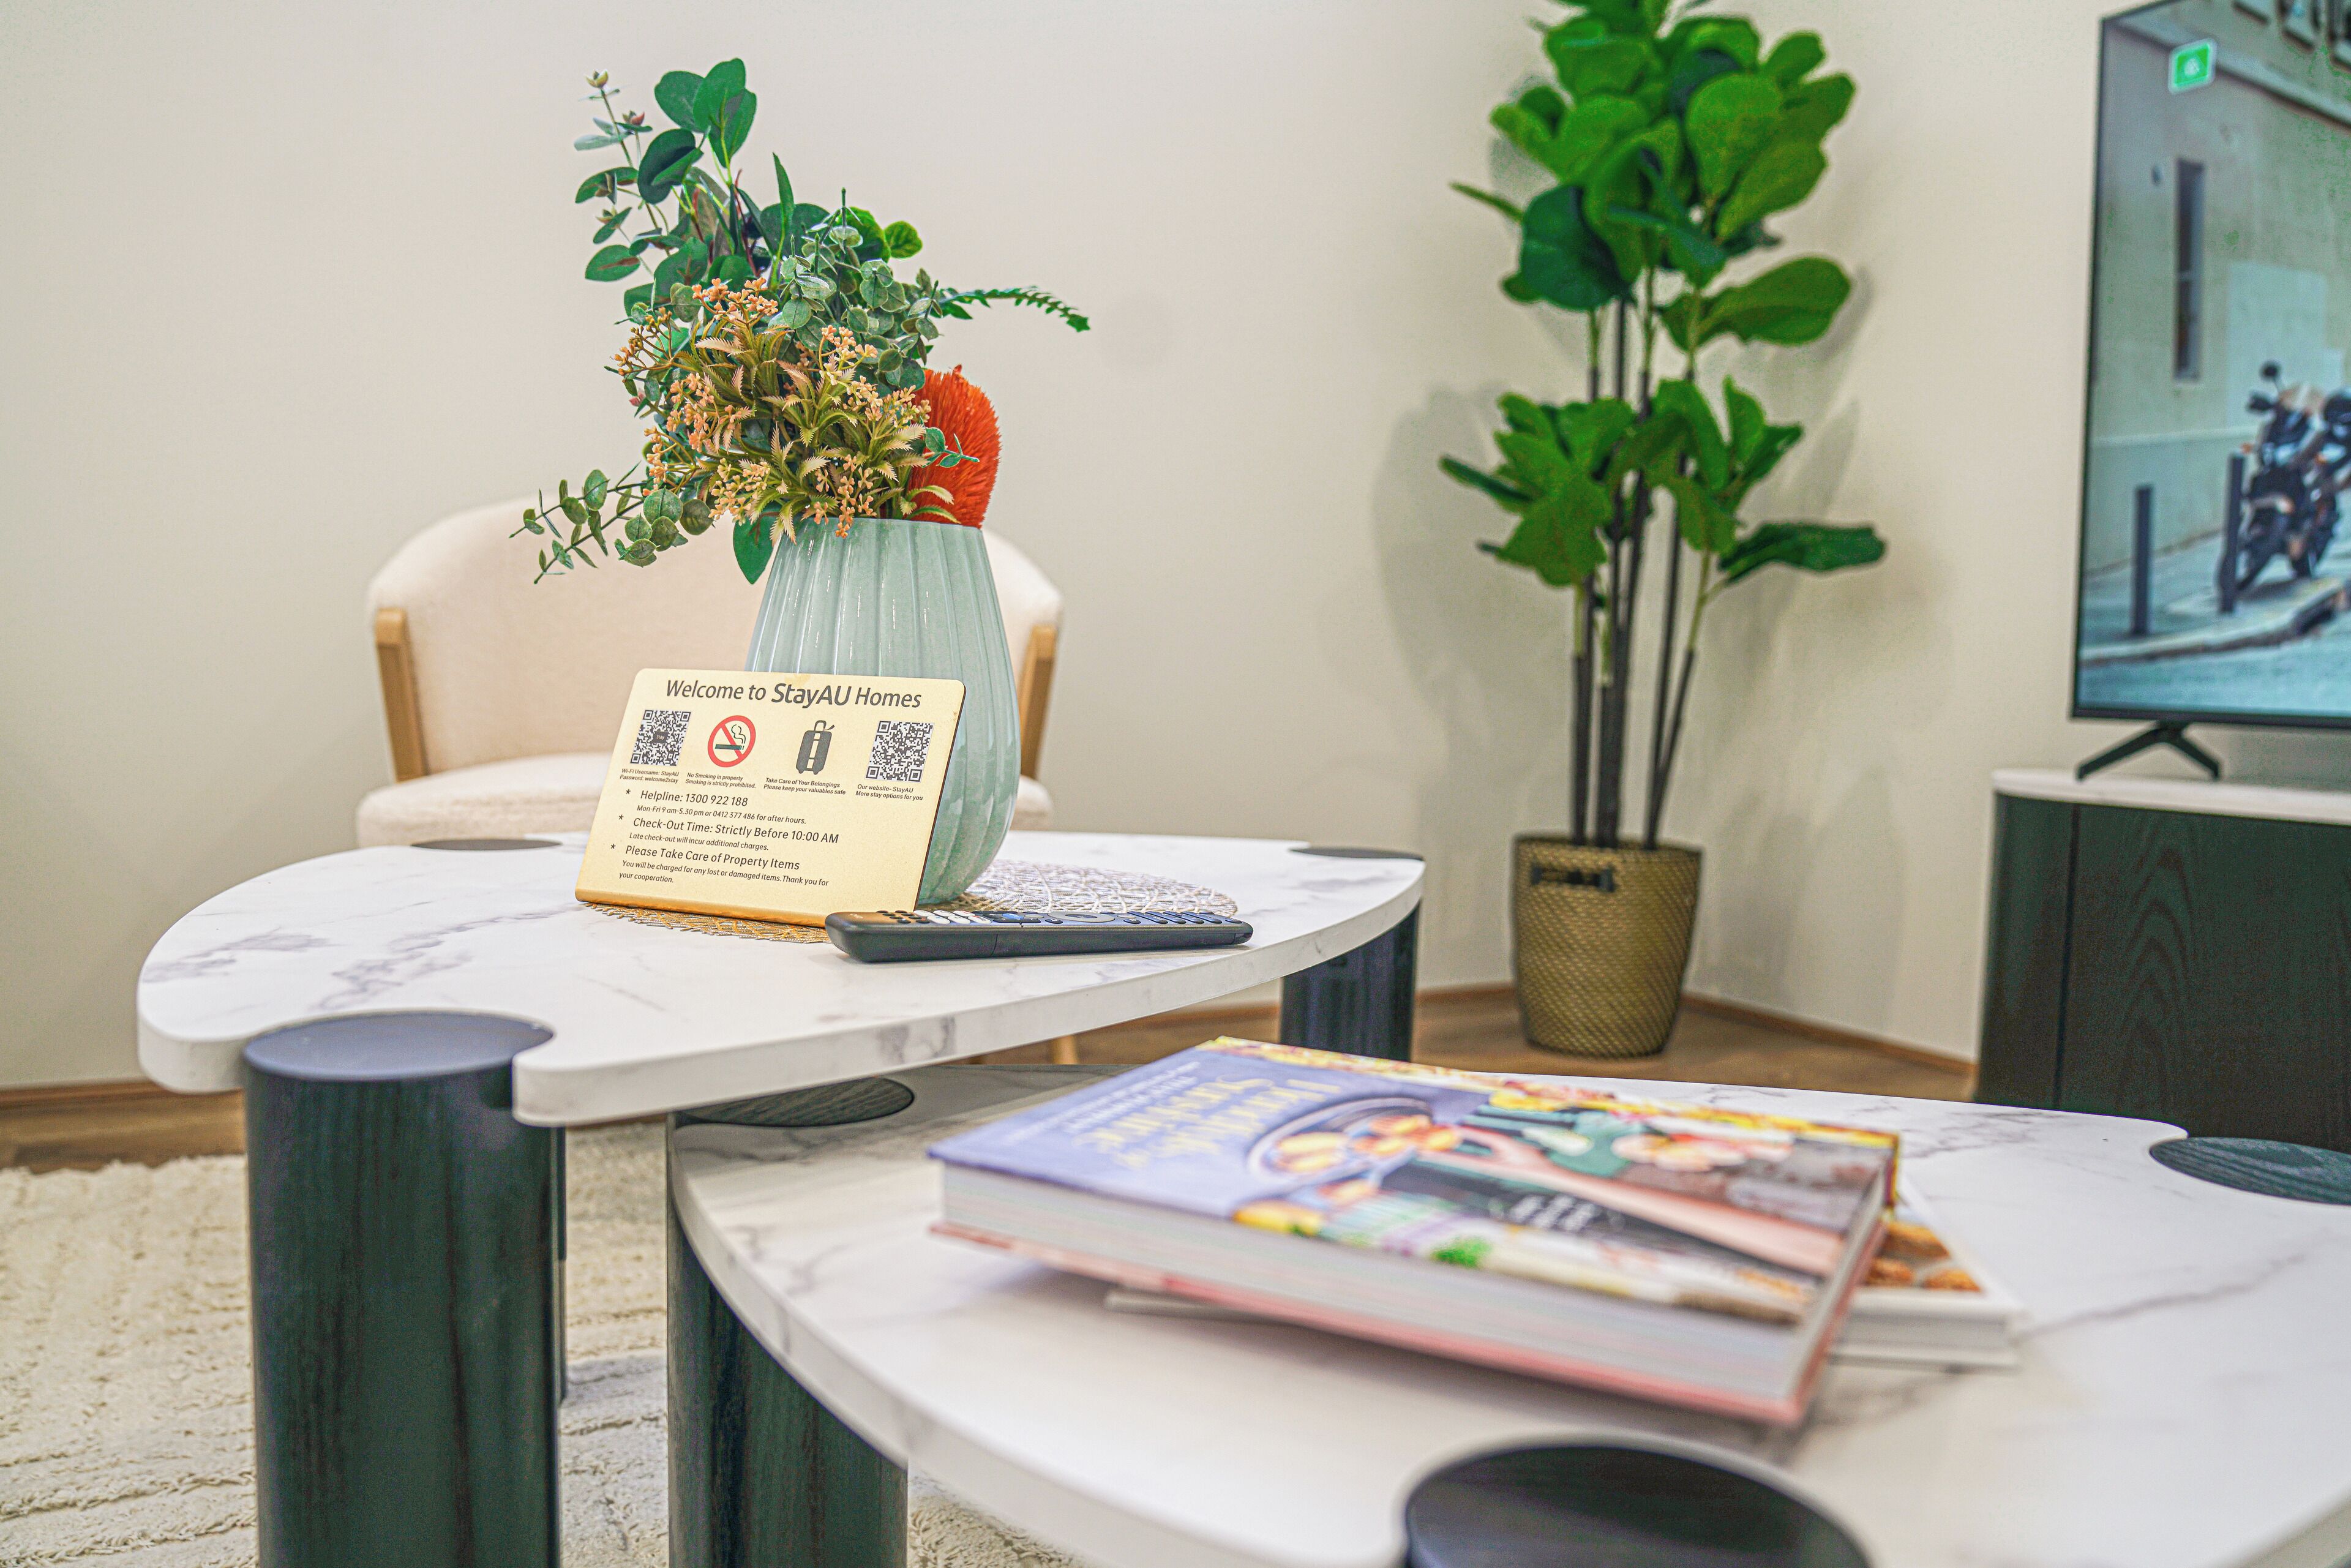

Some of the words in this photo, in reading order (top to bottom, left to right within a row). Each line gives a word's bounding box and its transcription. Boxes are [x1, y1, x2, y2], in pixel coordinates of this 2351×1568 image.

[667, 680, 744, 699] Welcome
[749, 685, 766, 700] to
[771, 683, 852, 708] StayAU
[855, 687, 921, 708] Homes
[640, 790, 683, 802] Helpline:
[686, 793, 708, 803] 1300
[711, 795, 729, 805] 922
[732, 797, 748, 806] 188
[634, 818, 684, 830] Check-Out
[687, 822, 713, 833] Time:
[715, 824, 752, 838] Strictly
[754, 827, 789, 839] Before
[792, 830, 819, 841] 10:00
[820, 833, 839, 843] AM
[644, 834, 676, 842] check-out
[741, 841, 768, 851] charges.
[626, 845, 658, 857] Please
[661, 849, 683, 859] Take
[686, 851, 709, 861] Care
[711, 853, 723, 862] of
[723, 853, 769, 869] Property
[770, 858, 800, 870] Items
[634, 874, 673, 883] cooperation.
[656, 863, 683, 872] charged
[729, 869, 760, 880] damaged
